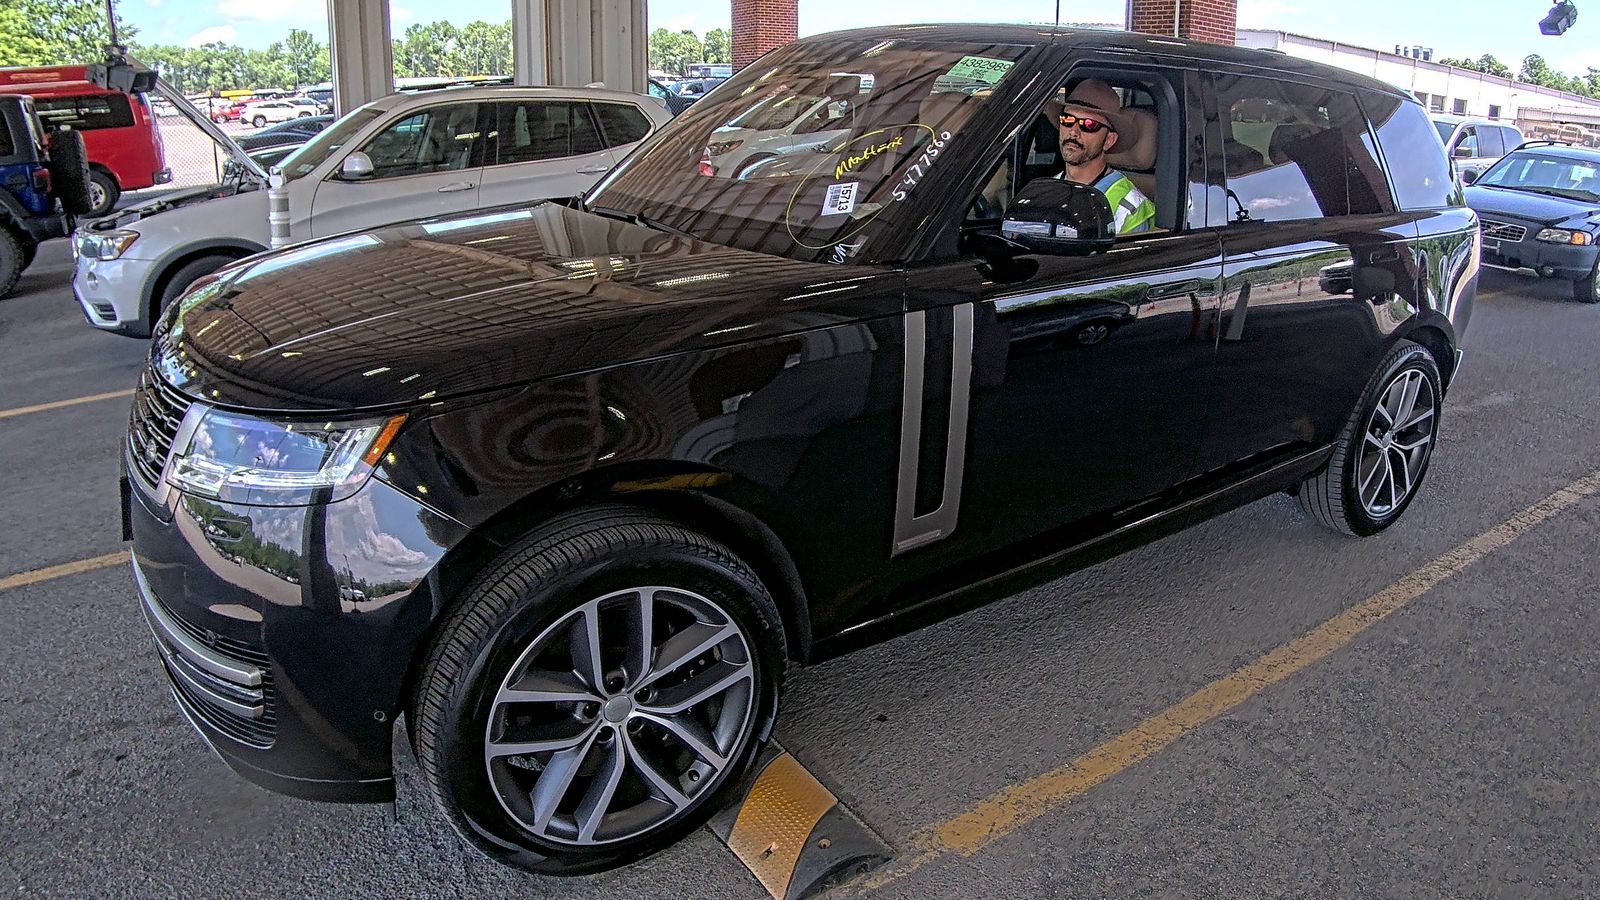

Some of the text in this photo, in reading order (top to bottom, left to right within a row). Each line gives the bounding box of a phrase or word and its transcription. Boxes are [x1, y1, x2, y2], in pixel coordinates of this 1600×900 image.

[960, 58, 1012, 73] 4382989
[892, 131, 951, 201] 5477560
[837, 184, 853, 211] T5713
